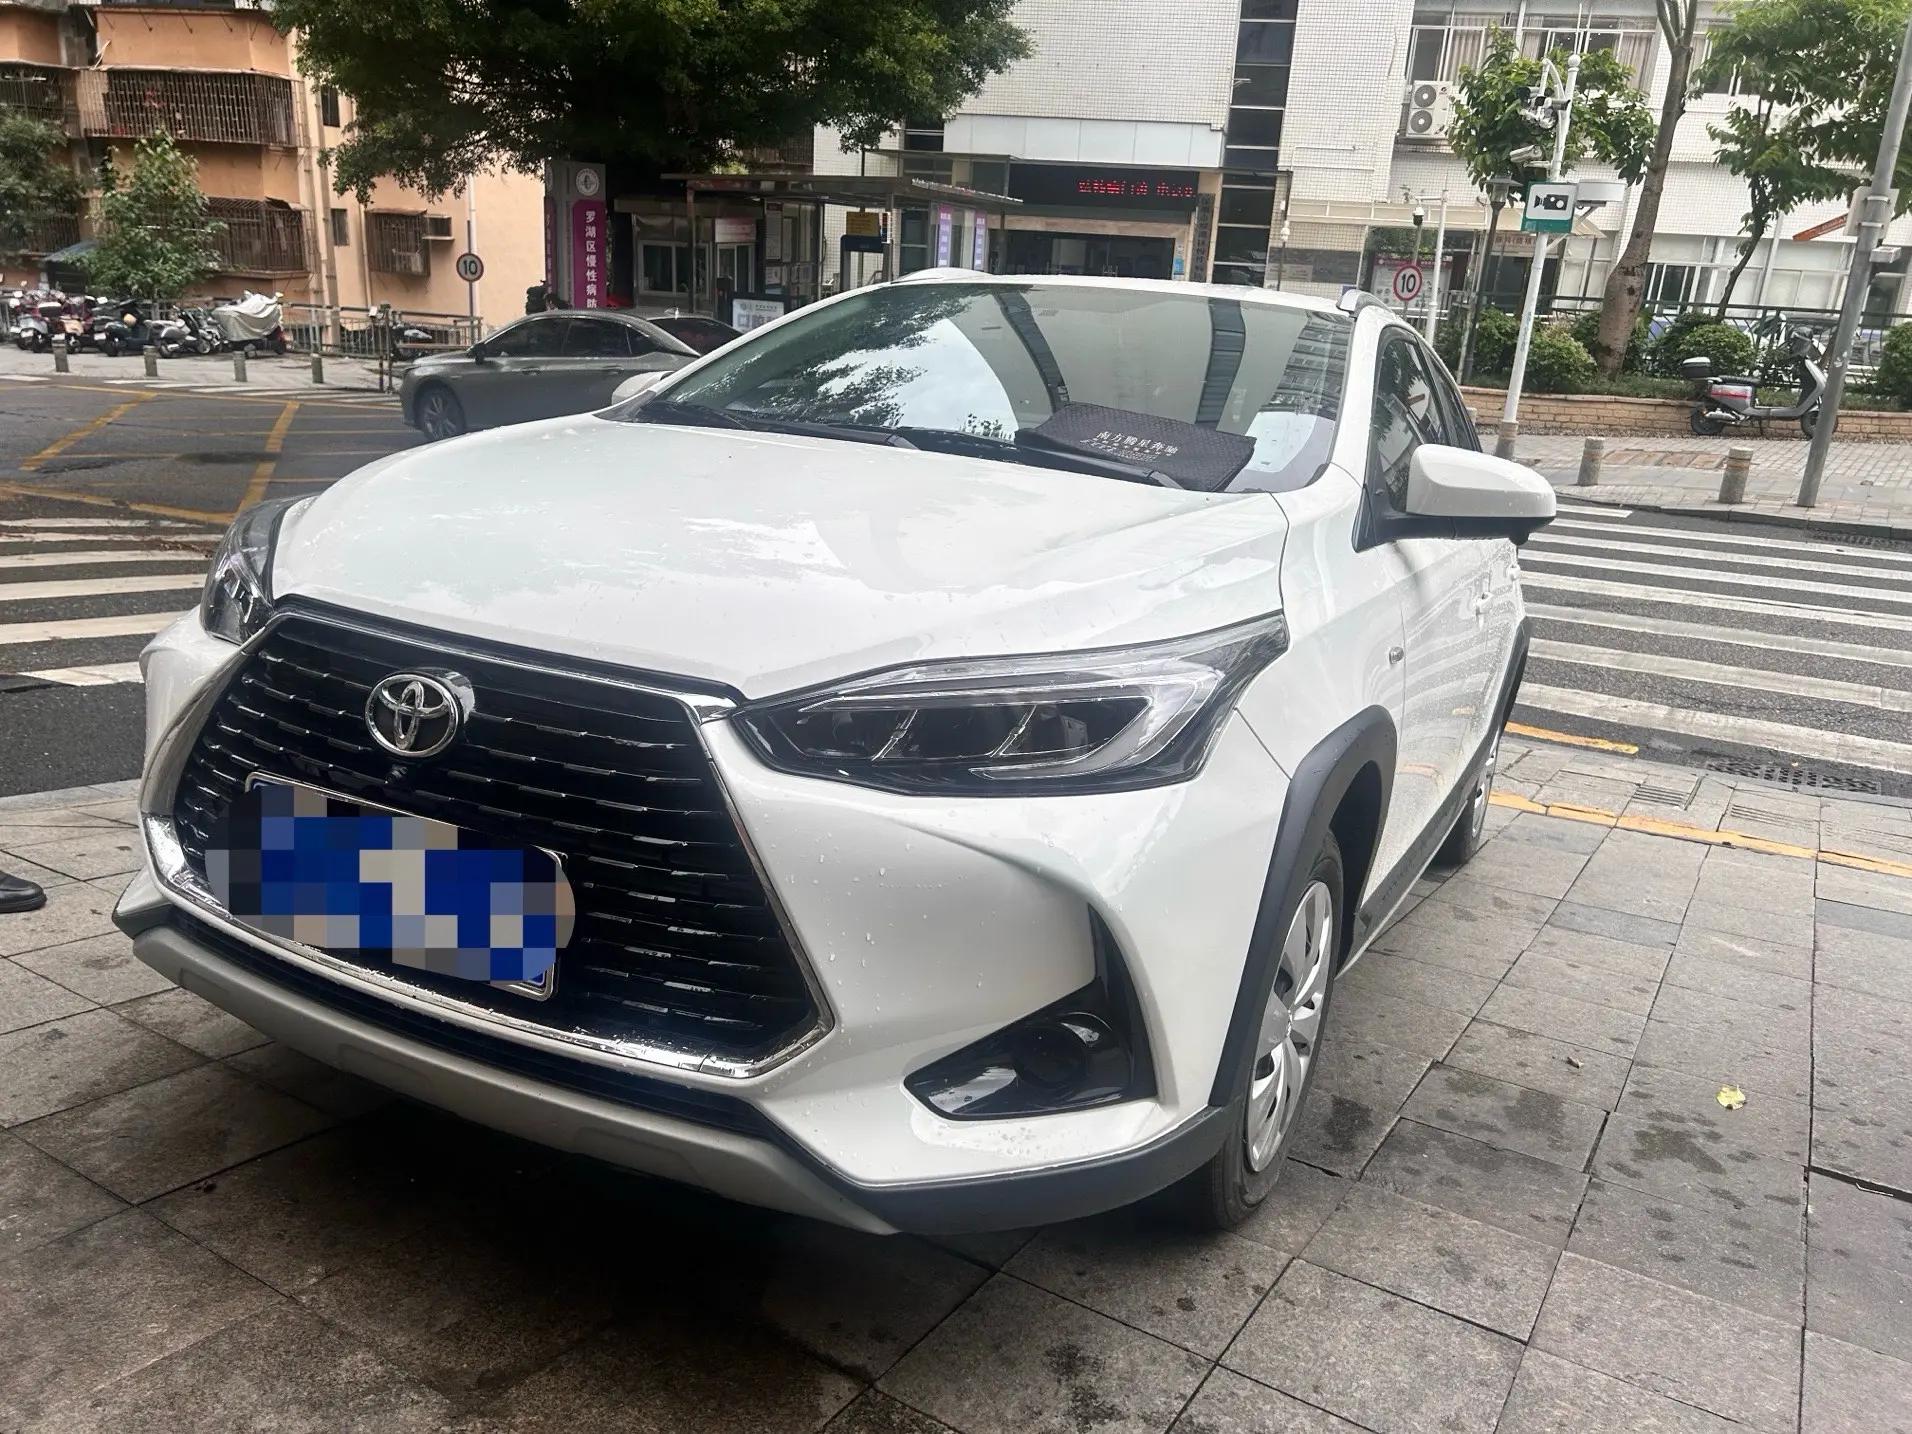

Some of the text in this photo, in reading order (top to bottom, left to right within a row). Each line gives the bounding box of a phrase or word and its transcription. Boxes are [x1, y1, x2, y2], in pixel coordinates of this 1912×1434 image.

[463, 260, 478, 275] 10
[585, 211, 598, 308] 罗湖区慢性病防
[1401, 273, 1416, 293] 10
